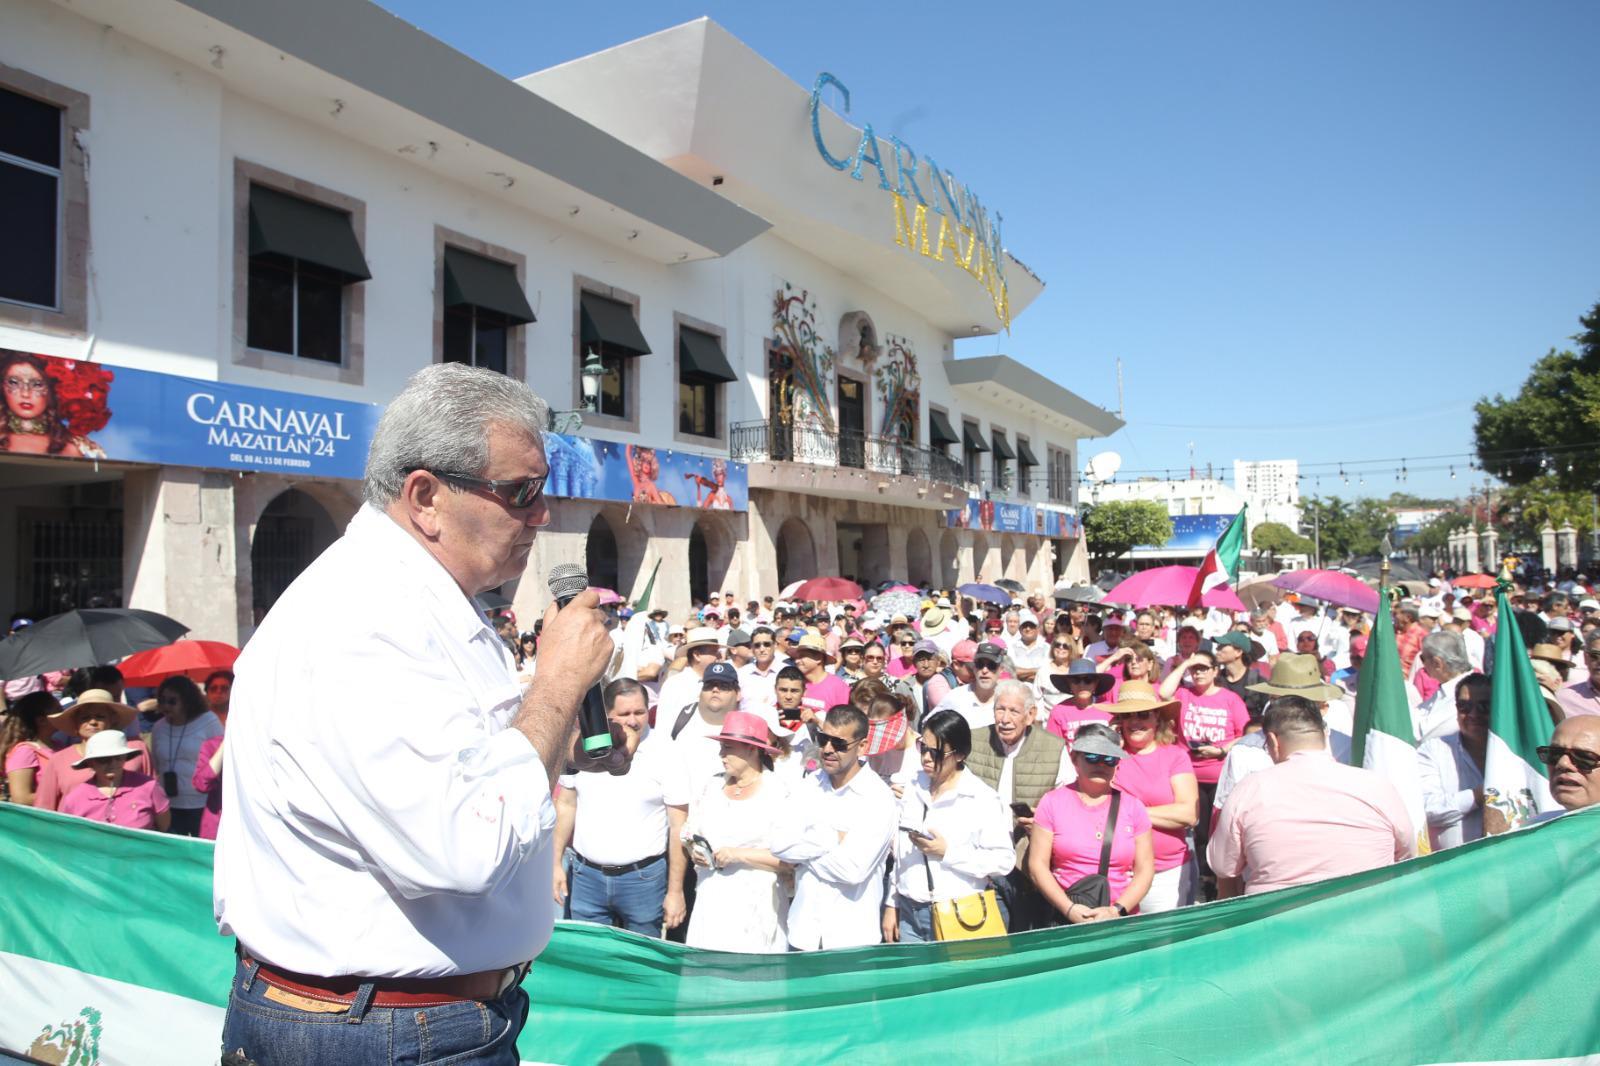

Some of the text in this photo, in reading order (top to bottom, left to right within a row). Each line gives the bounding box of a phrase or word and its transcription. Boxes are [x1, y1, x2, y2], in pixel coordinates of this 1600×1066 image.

[186, 393, 350, 440] CARNAVAL
[230, 453, 243, 463] DEL
[254, 456, 263, 465] AL
[273, 457, 282, 466] DE
[283, 458, 311, 469] FEBRERO
